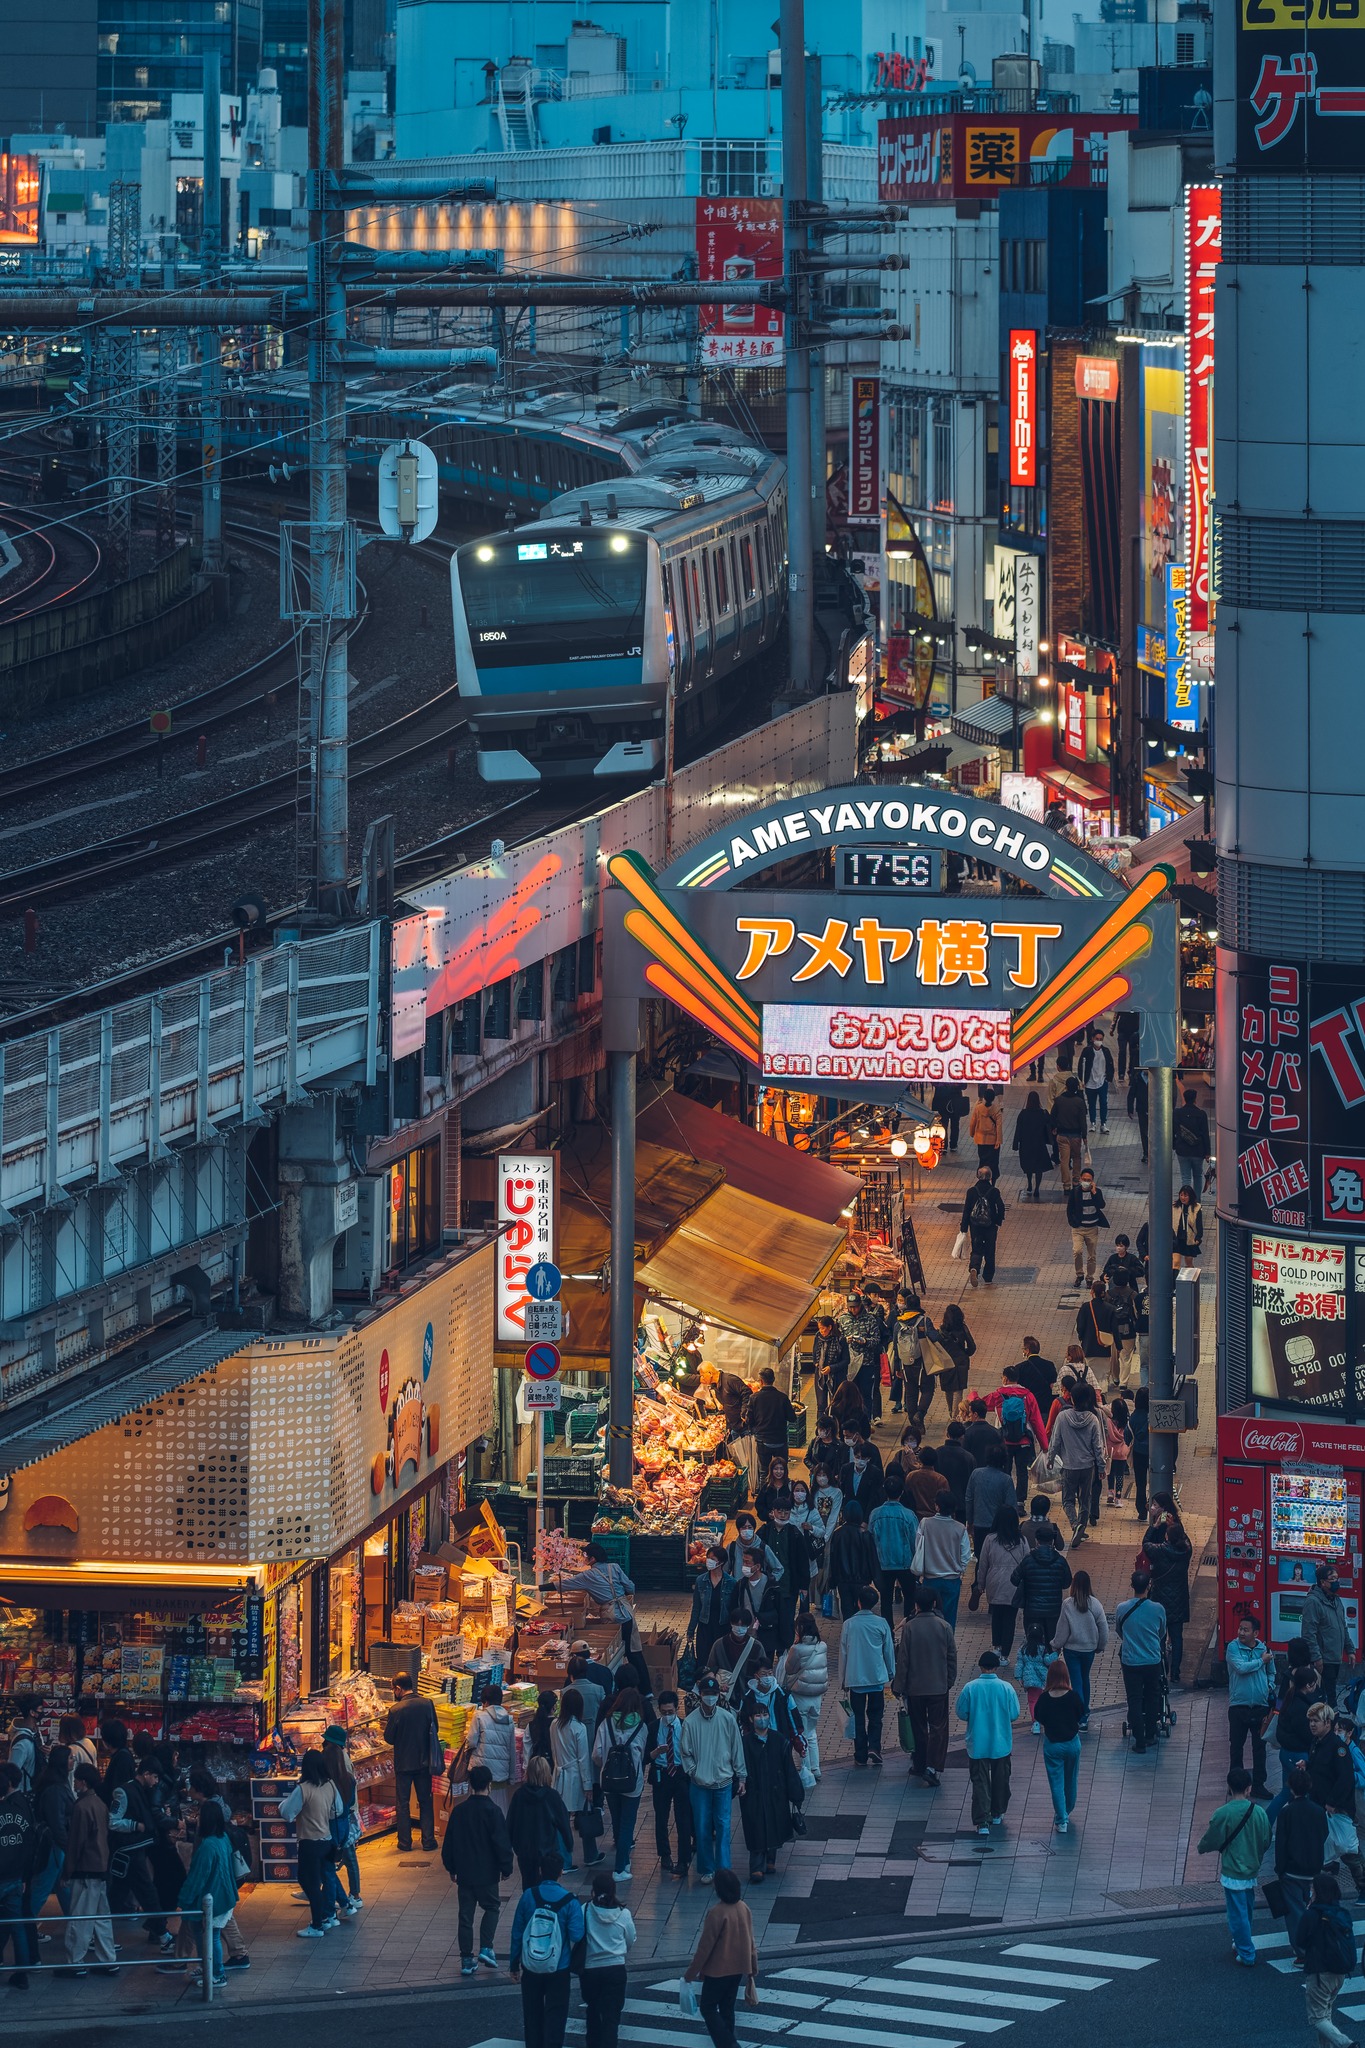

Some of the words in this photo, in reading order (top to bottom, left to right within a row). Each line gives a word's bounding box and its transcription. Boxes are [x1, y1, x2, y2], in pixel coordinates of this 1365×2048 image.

[880, 132, 931, 184] サンドラッグ
[970, 132, 1015, 179] 薬
[1015, 363, 1030, 475] GAME
[859, 420, 873, 511] サンドラッグ
[550, 541, 583, 555] 大宮
[1019, 562, 1036, 651] 牛かつもと村
[479, 631, 507, 641] 1650A
[627, 647, 641, 655] JR
[729, 801, 1050, 870] AMEYAYOKOCHO
[849, 854, 930, 886] 17:56
[735, 917, 1062, 989] アメヤ横丁
[816, 1052, 944, 1081] anywhere
[948, 1054, 1010, 1081] else.
[1242, 1004, 1266, 1130] カメラ
[1267, 965, 1301, 1133] ヨドバシ
[502, 1164, 551, 1174] レストラン
[1238, 1138, 1279, 1189] TAX
[1261, 1159, 1310, 1210] FREE
[1329, 1167, 1365, 1214] 免
[538, 1179, 549, 1243] 東京名物
[1272, 1207, 1305, 1227] STORE
[1252, 1237, 1345, 1266] ヨドバシカメラ
[1280, 1266, 1307, 1279] GOLD
[1311, 1270, 1344, 1283] POINT
[1290, 1360, 1322, 1378] 4980
[1244, 1429, 1300, 1453] Coca-Cola
[1312, 1441, 1332, 1449] TASTE
[1333, 1442, 1347, 1450] THE
[1, 1833, 23, 1846] USA
